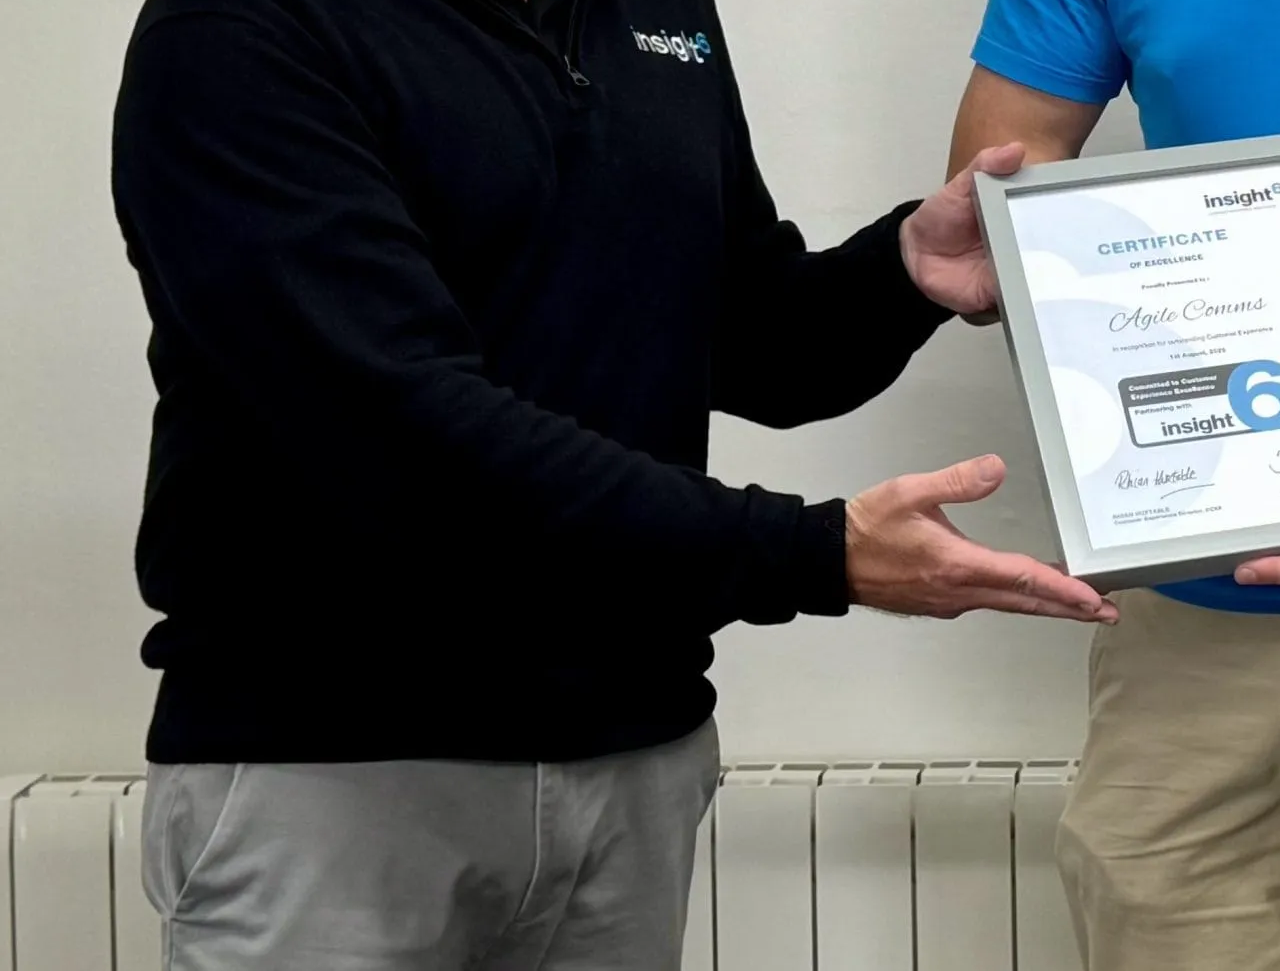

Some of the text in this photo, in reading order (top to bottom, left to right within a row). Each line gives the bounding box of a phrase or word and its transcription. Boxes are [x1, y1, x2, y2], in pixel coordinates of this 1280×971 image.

[1097, 228, 1228, 255] CERTIFICATE
[1129, 253, 1204, 269] OF EXCELLENCE
[1141, 282, 1166, 291] Proudly
[1167, 277, 1198, 287] Presented
[1108, 297, 1267, 332] Agile Comms
[1128, 380, 1170, 392] Committed
[1180, 374, 1217, 385] Customer
[1130, 384, 1216, 401] Experience Excellence
[1134, 402, 1193, 416] Partnering with
